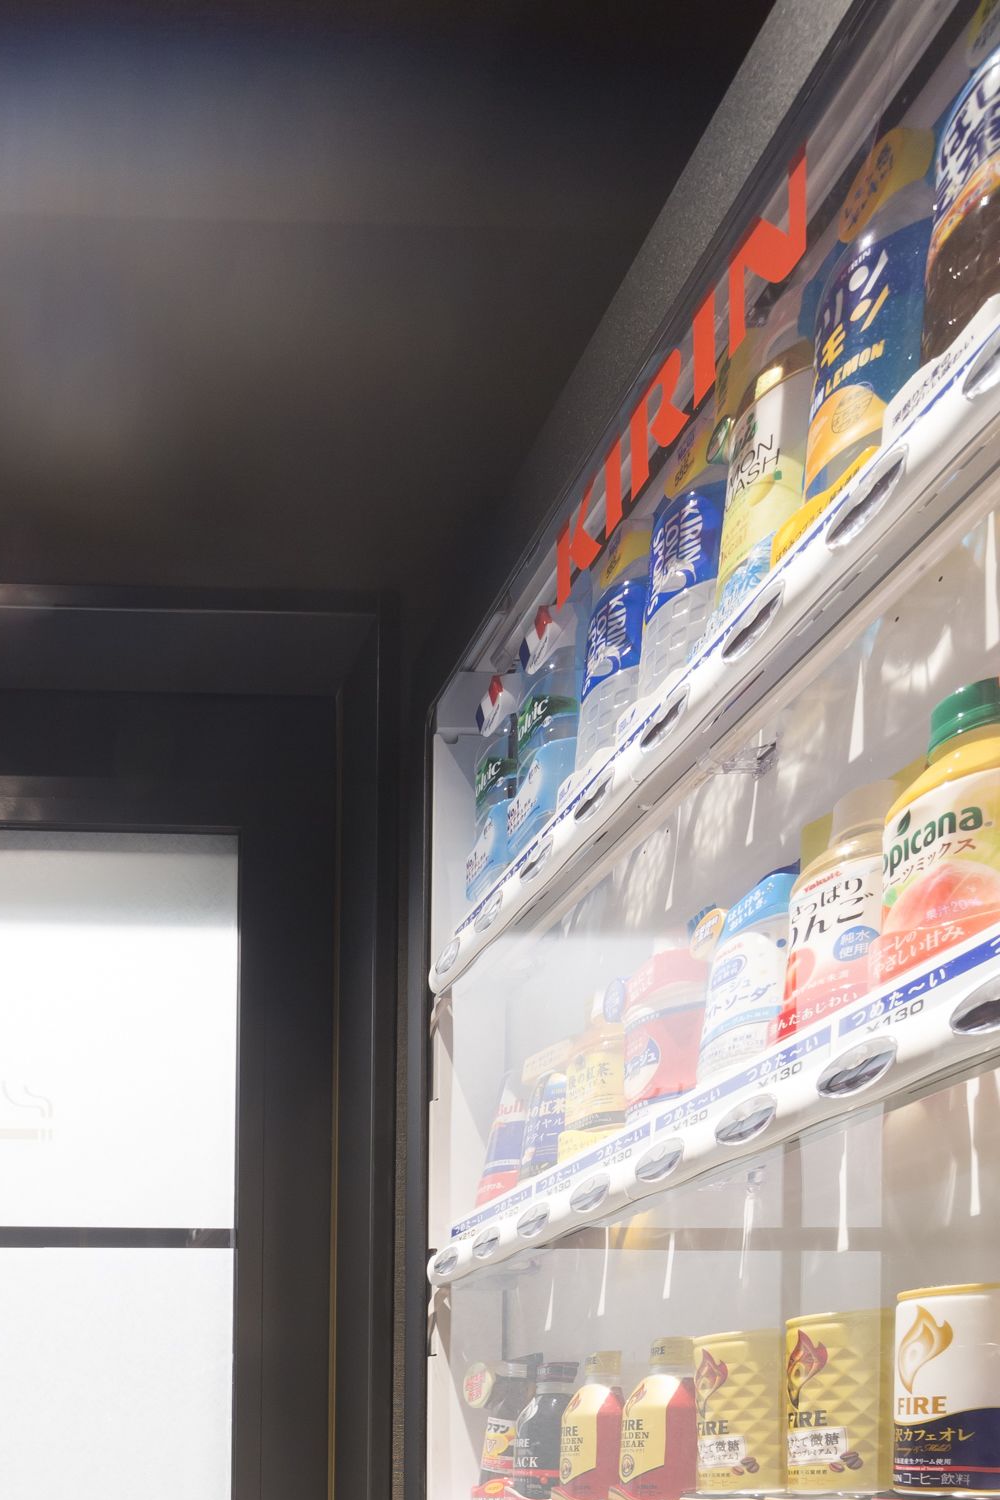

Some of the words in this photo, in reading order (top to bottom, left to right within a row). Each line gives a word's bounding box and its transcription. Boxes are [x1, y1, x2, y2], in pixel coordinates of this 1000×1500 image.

[556, 141, 806, 611] KIRIN
[825, 340, 886, 397] LEMON
[679, 499, 703, 562] KIRIN
[606, 593, 628, 648] KIRIN
[518, 697, 549, 742] olvic
[791, 878, 863, 924] さっぱり
[851, 967, 948, 1028] つめた～い
[866, 998, 925, 1034] ¥130
[745, 1035, 820, 1082] つめた～い
[757, 1061, 803, 1088] ¥130
[673, 1110, 709, 1132] ¥130
[602, 1148, 633, 1168] ¥130
[787, 1409, 828, 1428] FIRE
[897, 1396, 947, 1416] FIRE
[486, 1422, 510, 1434] フマン
[697, 1420, 730, 1436] FIRE
